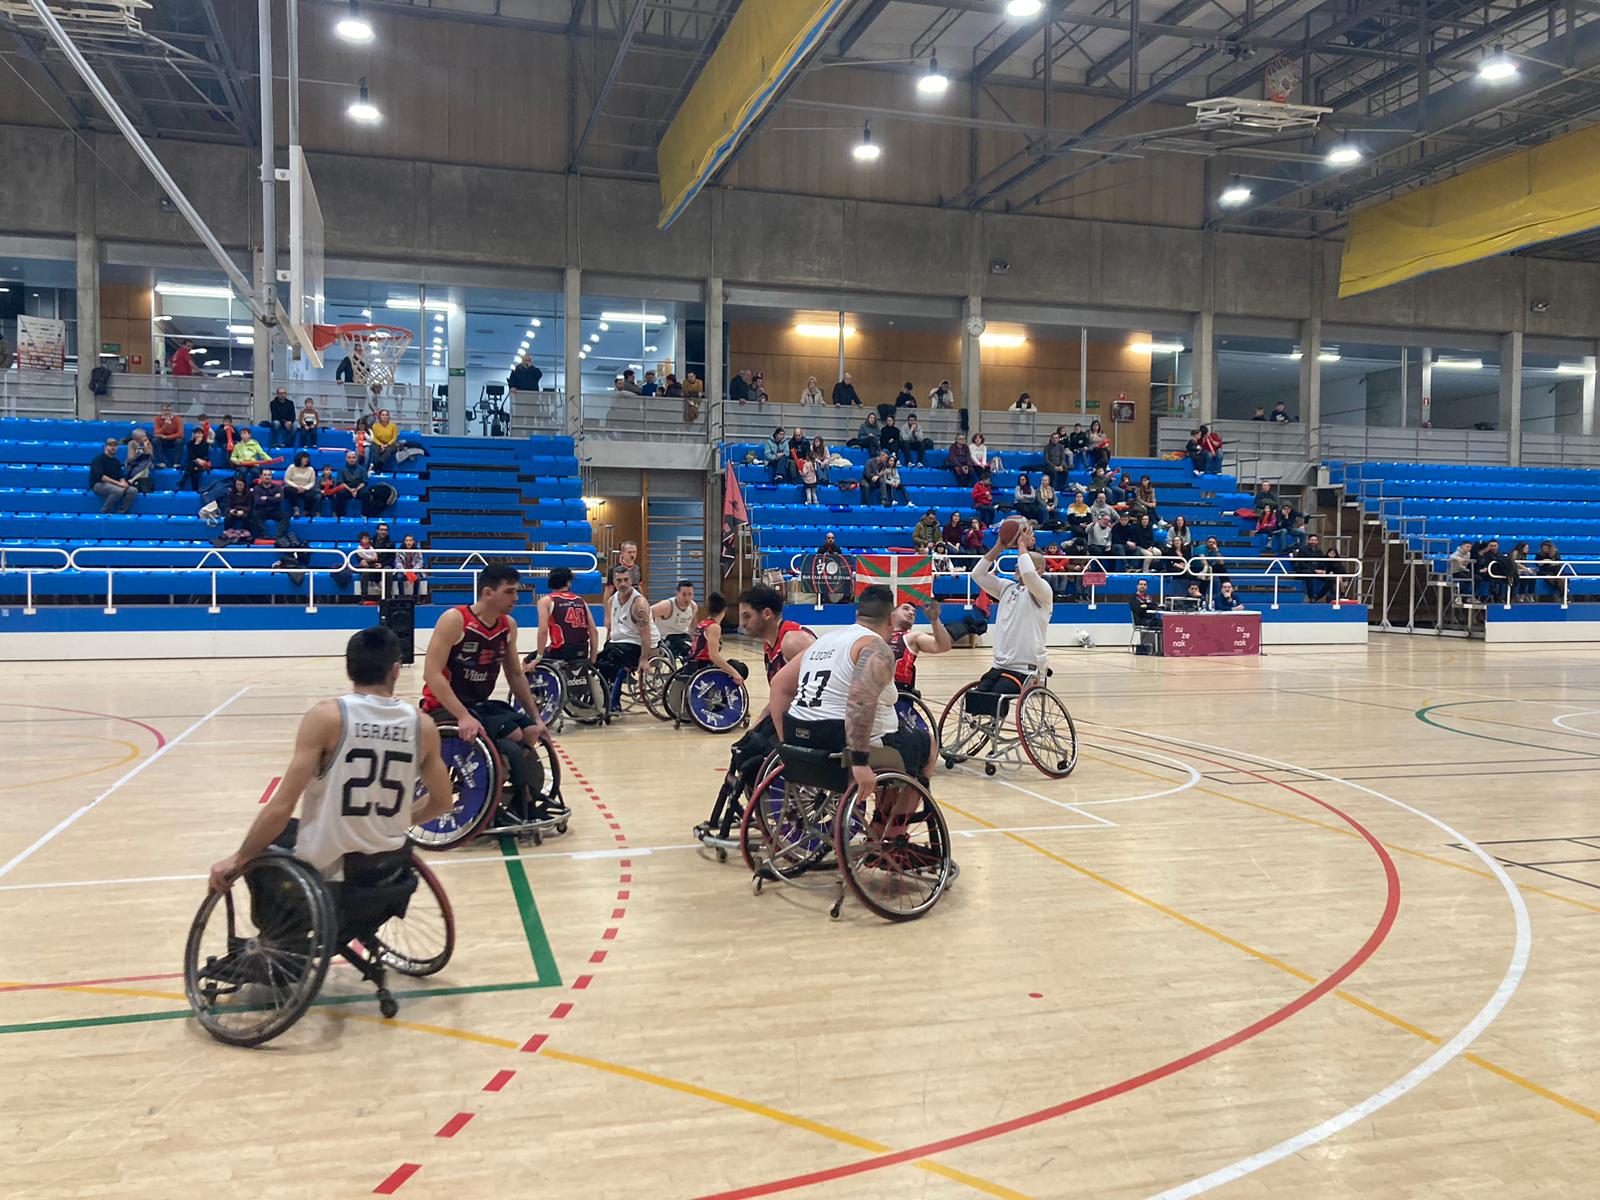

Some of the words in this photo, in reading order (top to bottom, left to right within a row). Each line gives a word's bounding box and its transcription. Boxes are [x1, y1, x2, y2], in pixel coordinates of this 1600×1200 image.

[796, 670, 832, 708] 17
[355, 723, 409, 743] ISRAEL
[342, 748, 413, 818] 25
